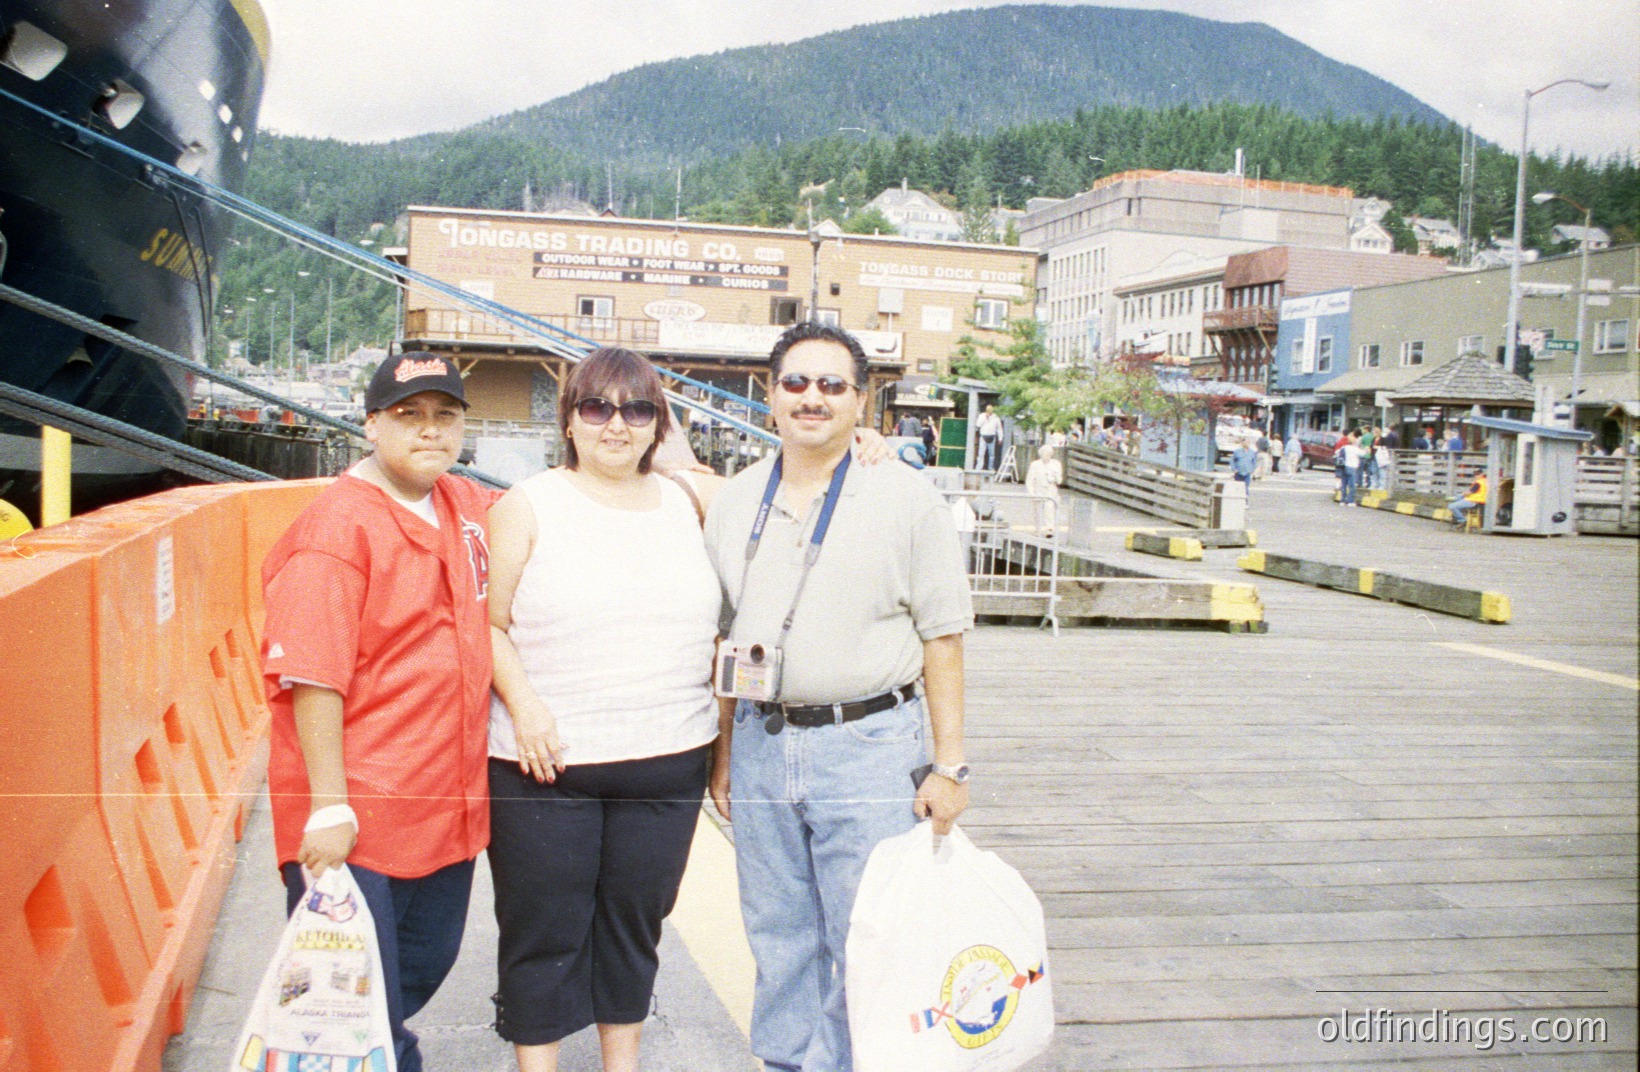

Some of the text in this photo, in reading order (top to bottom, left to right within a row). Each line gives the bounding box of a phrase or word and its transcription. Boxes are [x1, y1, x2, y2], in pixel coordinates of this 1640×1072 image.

[438, 217, 741, 261] TONGASS TRADING CO.
[542, 253, 780, 275] OUTDOOR WEAR FOOT WEAR SPT. GOODS
[858, 261, 929, 277] TONGASS
[934, 266, 974, 279] DOCK
[559, 269, 623, 281] HARDWARE
[643, 272, 691, 284] MARINE
[721, 277, 769, 289] CURIOS
[753, 502, 770, 534] SONY
[290, 1008, 328, 1017] ALASKA
